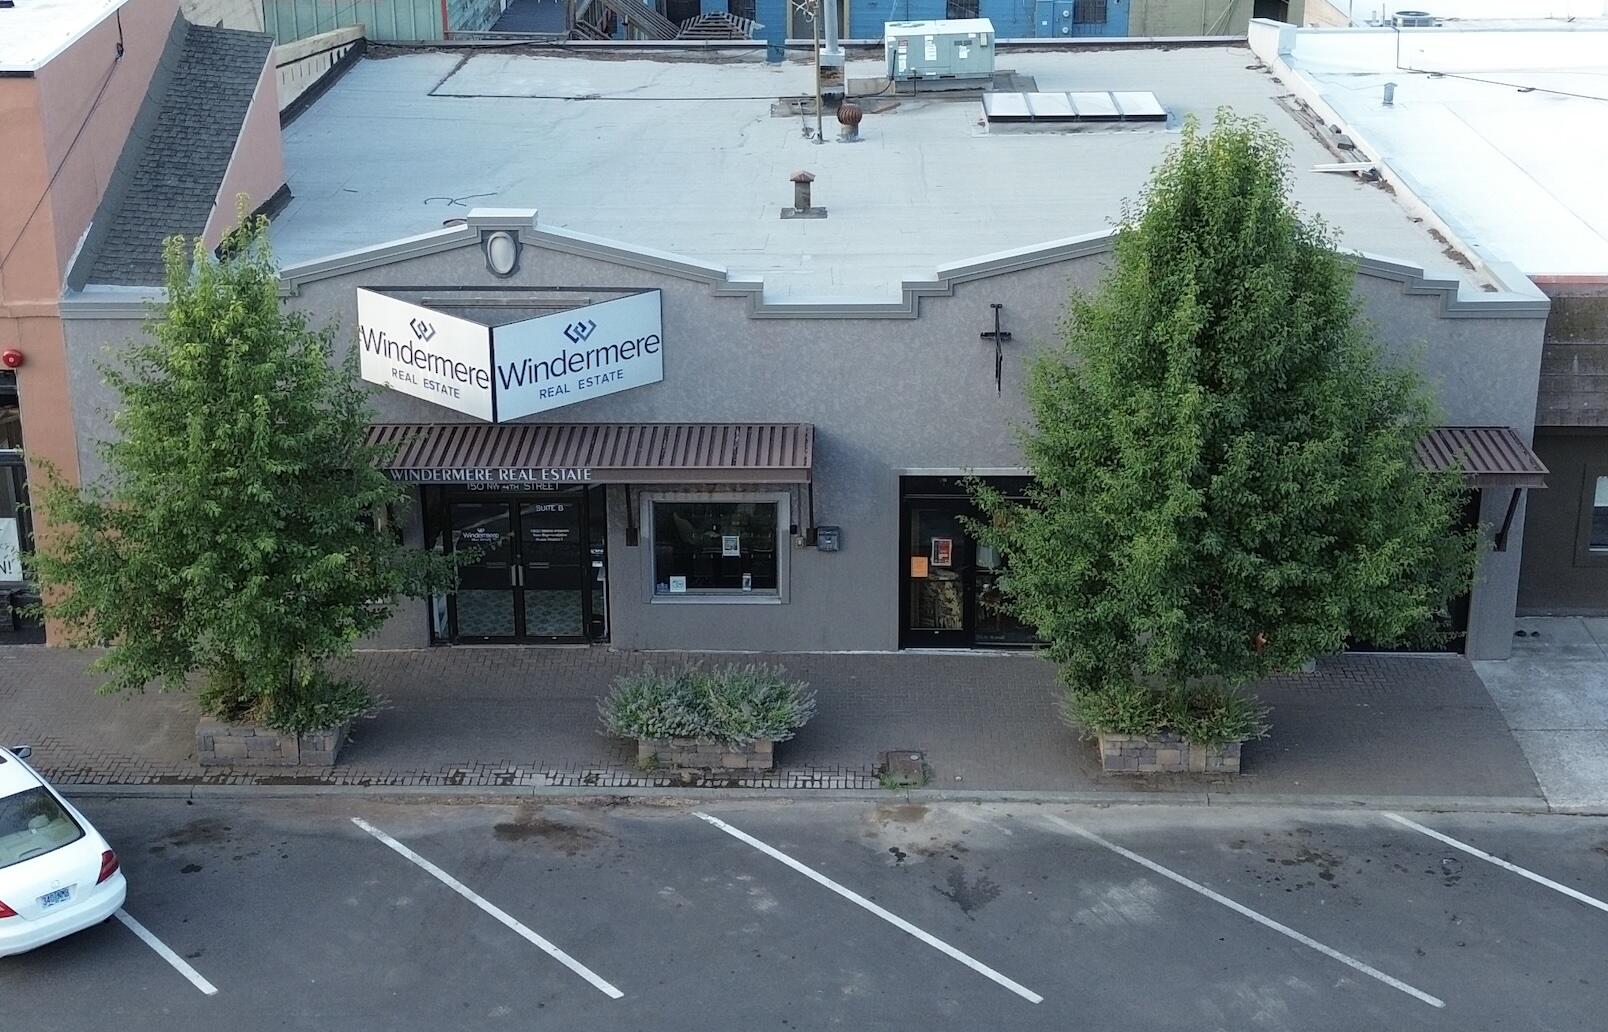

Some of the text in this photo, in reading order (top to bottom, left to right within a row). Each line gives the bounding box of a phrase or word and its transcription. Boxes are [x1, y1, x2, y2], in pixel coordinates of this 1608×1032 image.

[360, 324, 489, 390] Windermere
[498, 333, 660, 391] Windermere
[391, 367, 461, 399] REAL ESTATE
[539, 368, 624, 400] REAL ESTATE
[390, 468, 592, 481] WINDERMERE REAL ESTATE
[467, 482, 484, 491] 150
[523, 482, 560, 491] STREET
[535, 504, 556, 512] SUITE
